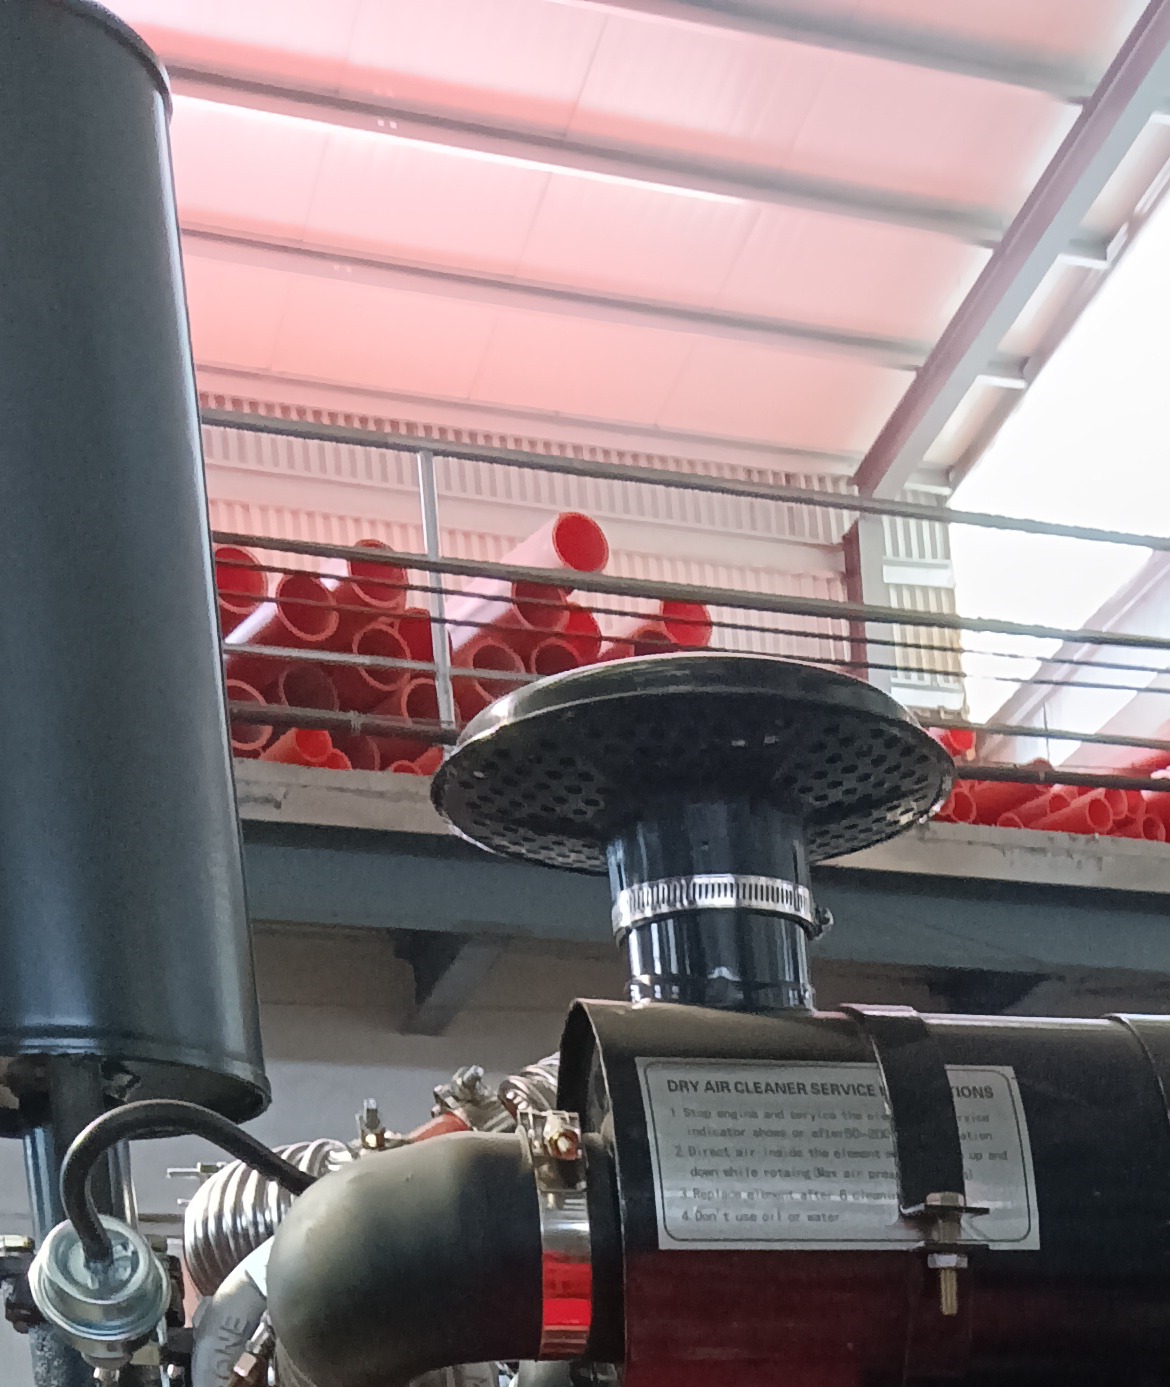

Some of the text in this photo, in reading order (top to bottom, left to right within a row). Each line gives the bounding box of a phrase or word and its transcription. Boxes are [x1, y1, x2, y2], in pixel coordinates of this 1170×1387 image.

[667, 1080, 699, 1092] DRY
[704, 1081, 732, 1093] AIR
[734, 1081, 808, 1095] CLEANER
[811, 1083, 877, 1096] SERVICE
